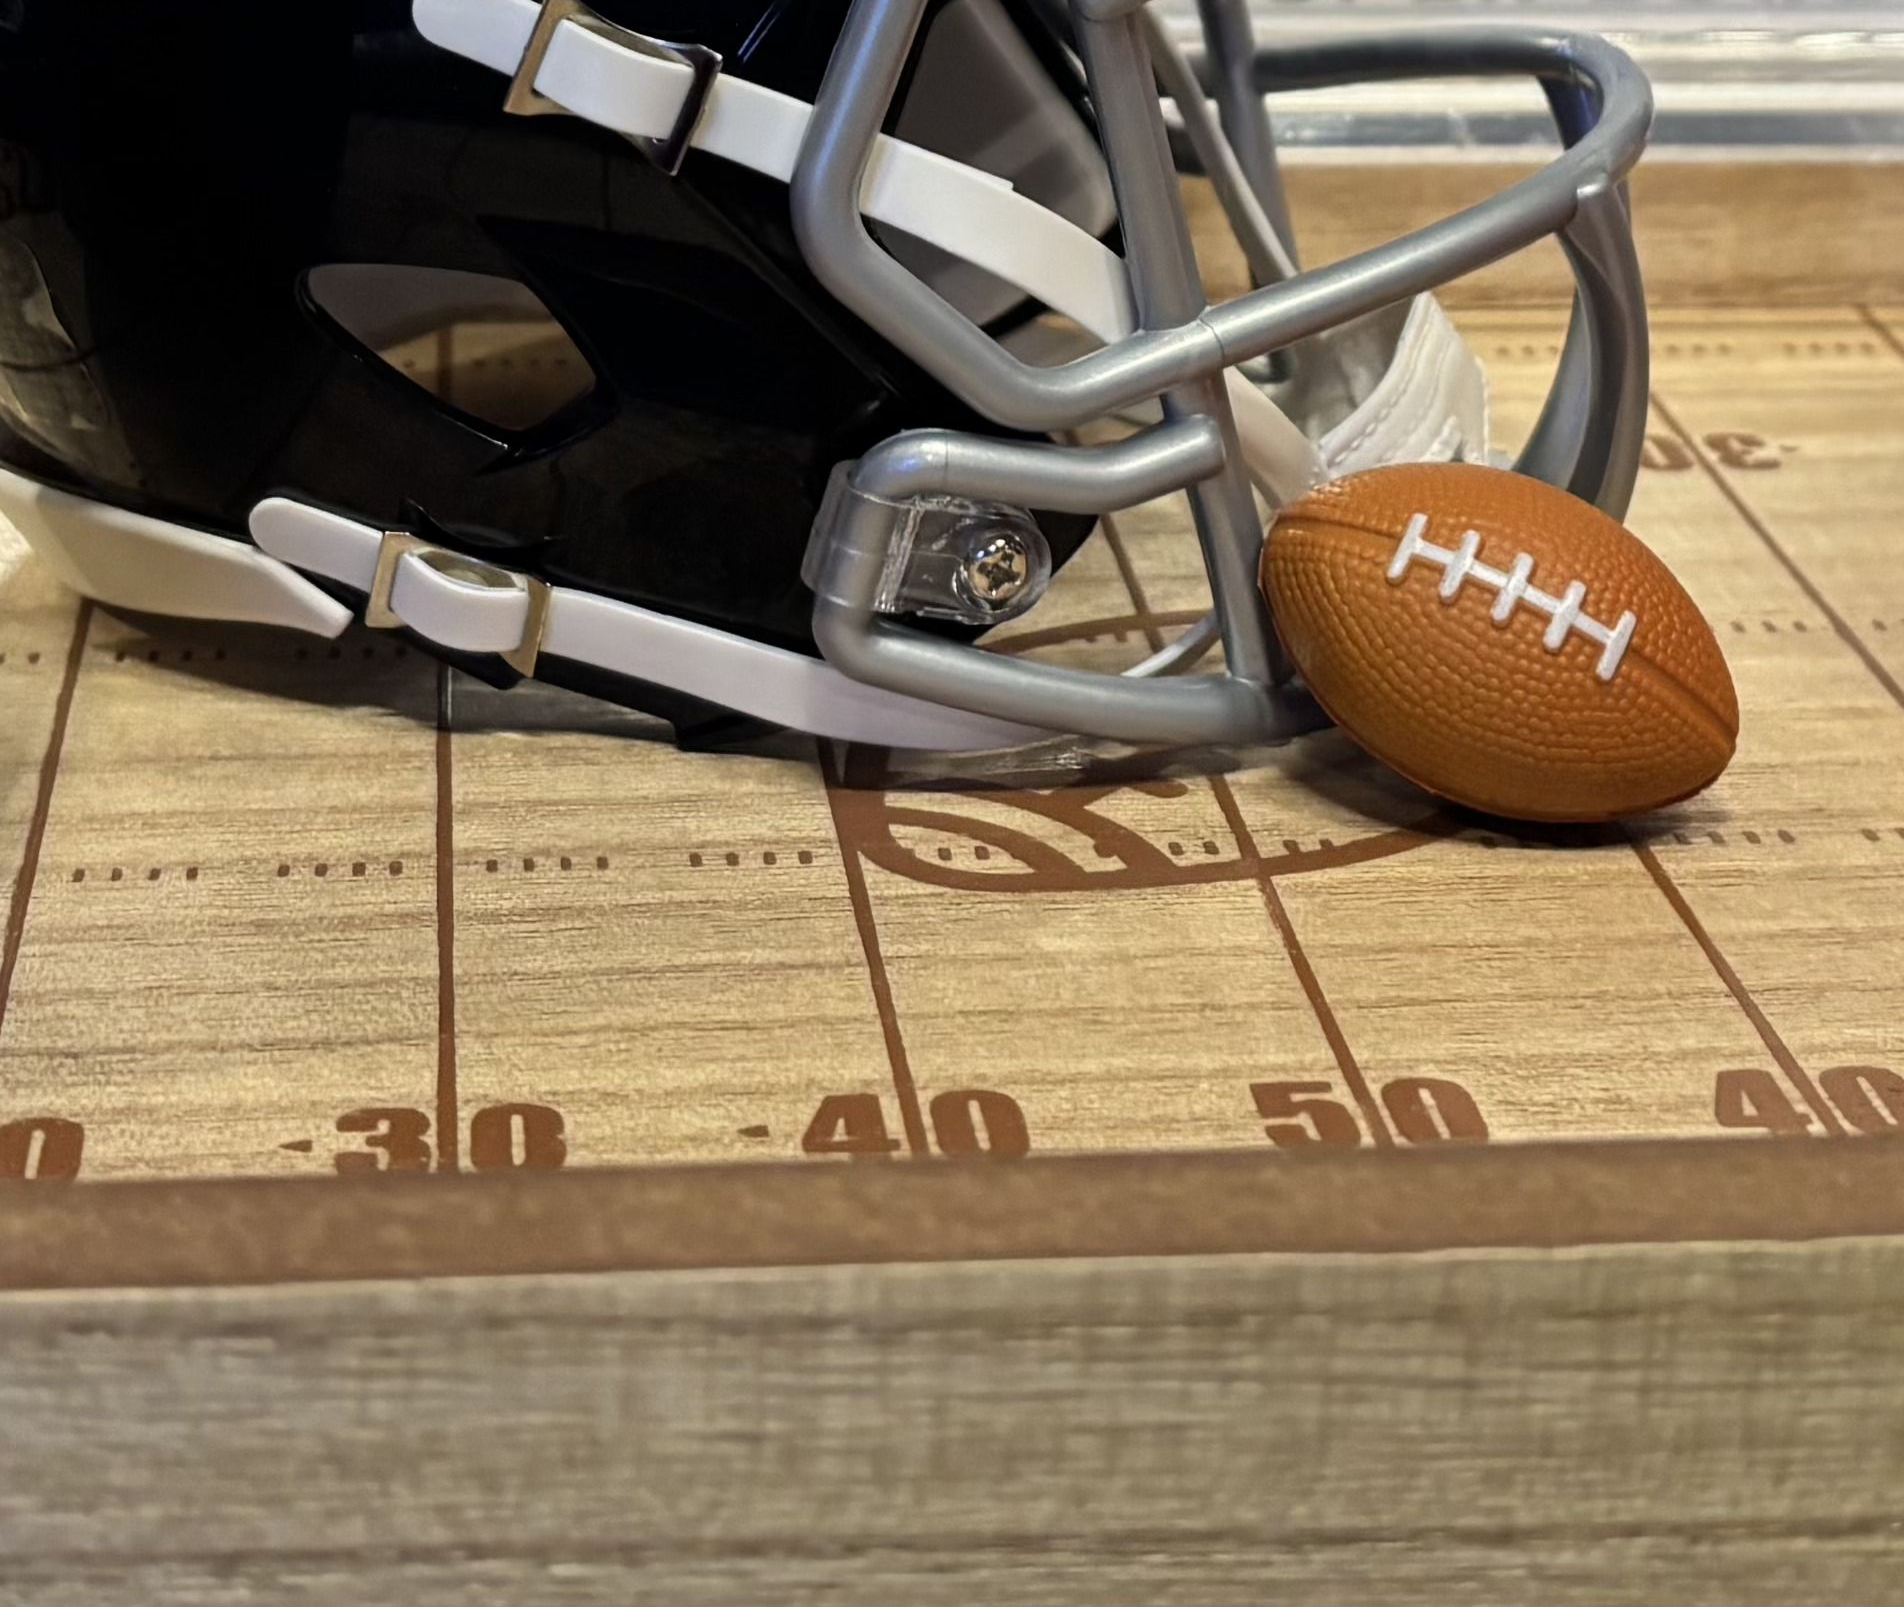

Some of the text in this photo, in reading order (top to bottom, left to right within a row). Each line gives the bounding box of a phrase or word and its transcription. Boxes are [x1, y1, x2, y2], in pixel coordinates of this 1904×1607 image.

[334, 1103, 568, 1173] 30
[801, 1089, 1032, 1158] 40
[1249, 1077, 1489, 1150] 50
